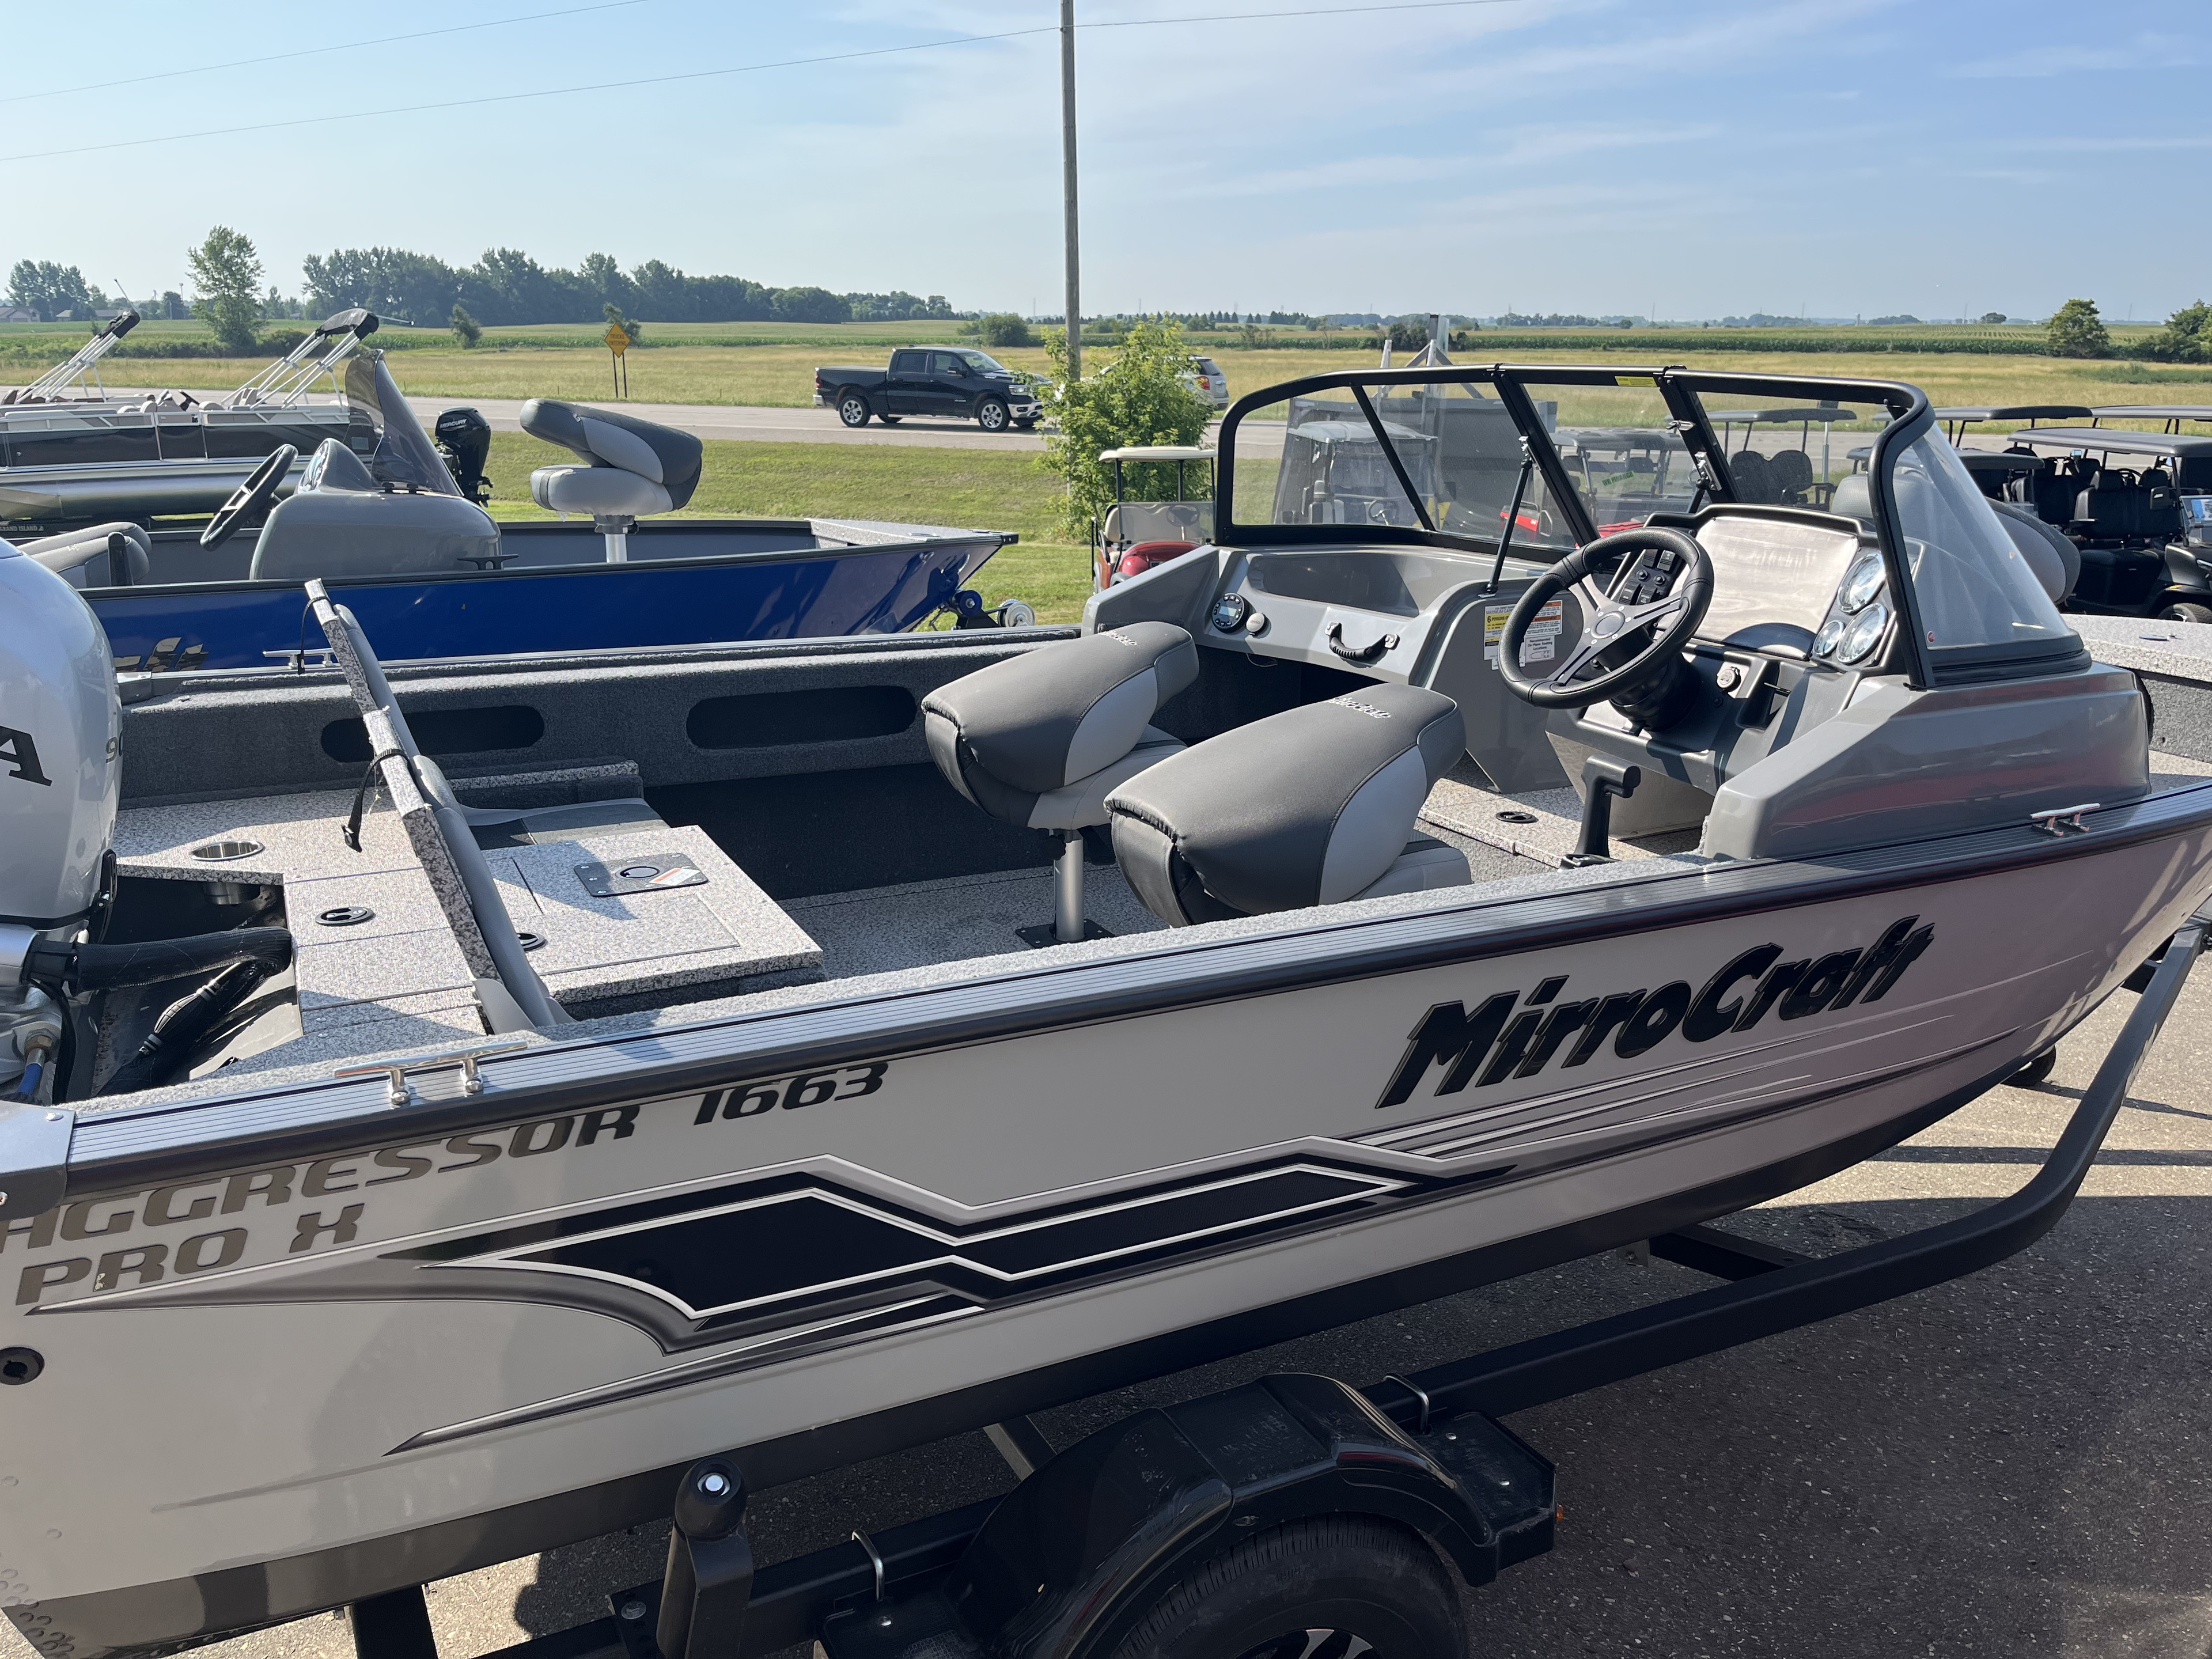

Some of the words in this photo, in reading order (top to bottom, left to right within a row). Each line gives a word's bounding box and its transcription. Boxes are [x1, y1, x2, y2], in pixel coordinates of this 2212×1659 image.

[440, 419, 467, 429] MERCURY
[1611, 471, 1634, 483] FINANCE
[1375, 914, 1935, 1109] MirroCraft
[694, 1061, 889, 1125] 1663
[16, 1228, 248, 1305] PRO
[290, 1202, 365, 1253] X
